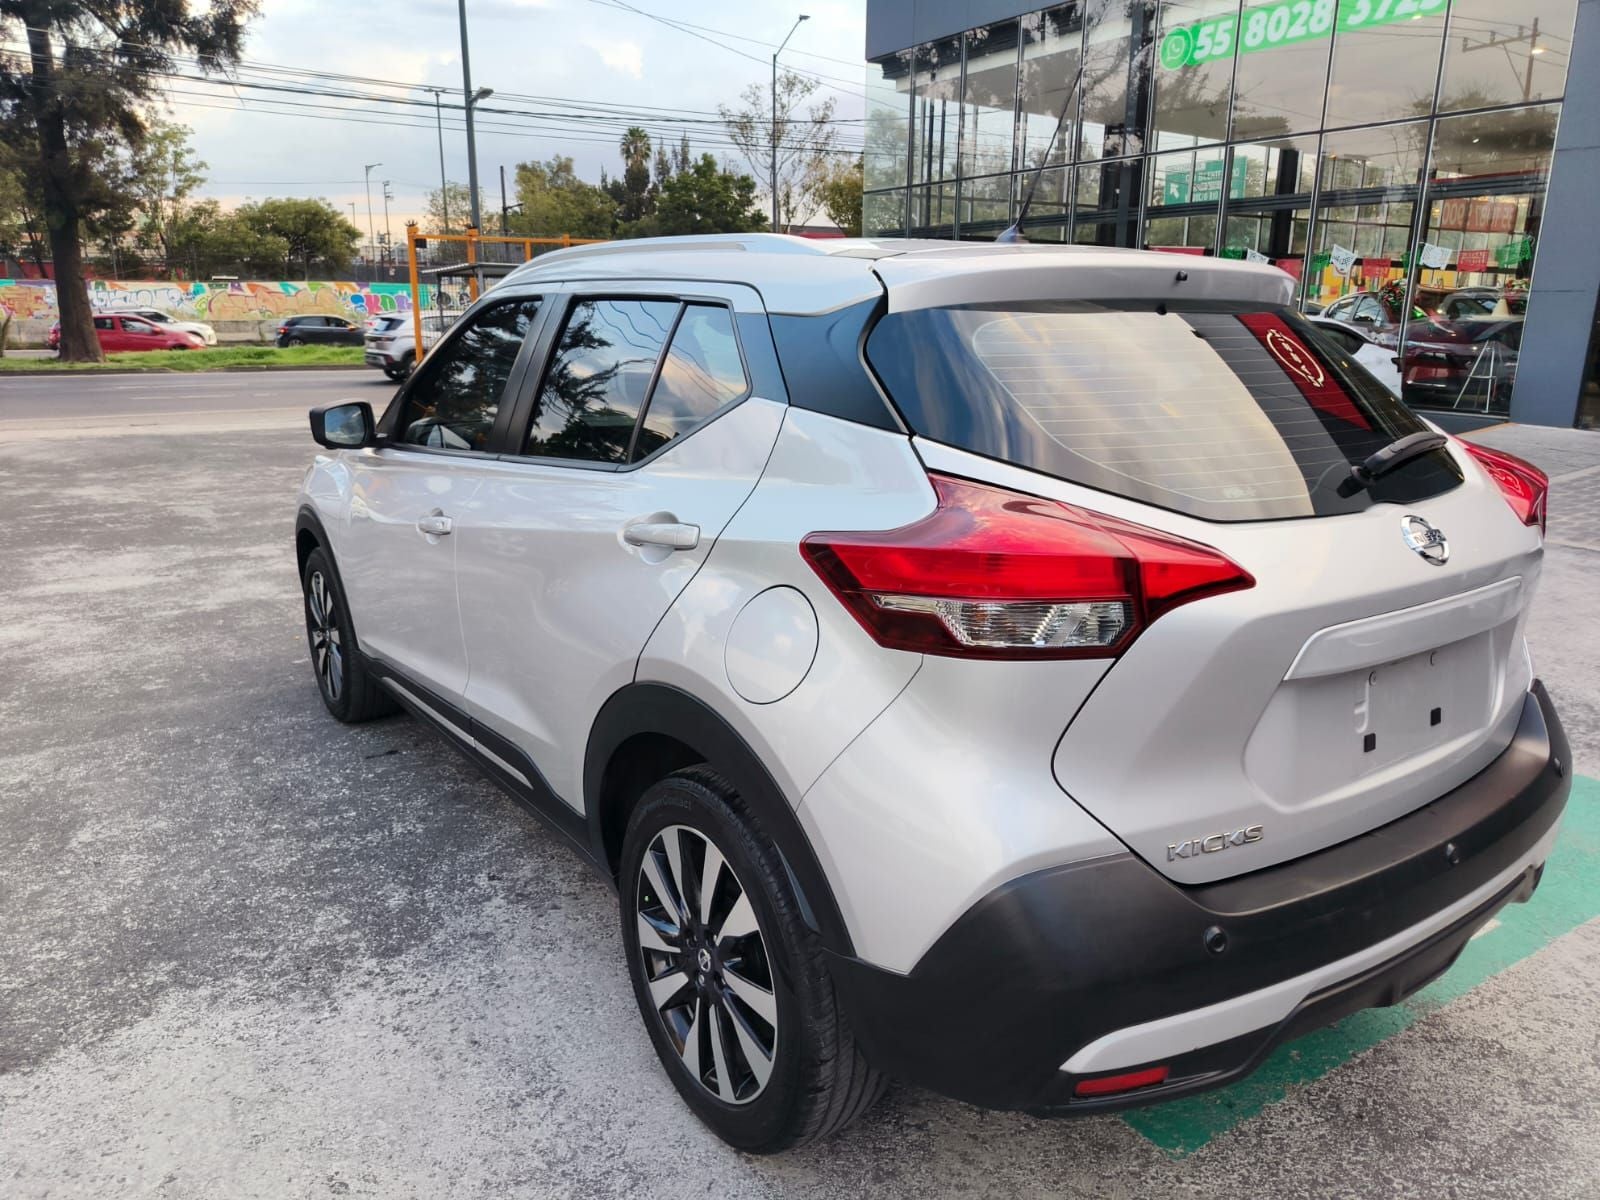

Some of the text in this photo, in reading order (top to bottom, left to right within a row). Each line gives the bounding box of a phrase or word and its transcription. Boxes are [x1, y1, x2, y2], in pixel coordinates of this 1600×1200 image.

[1194, 19, 1234, 60] 55
[1244, 0, 1333, 47] 8028
[1167, 824, 1264, 862] KICKS
